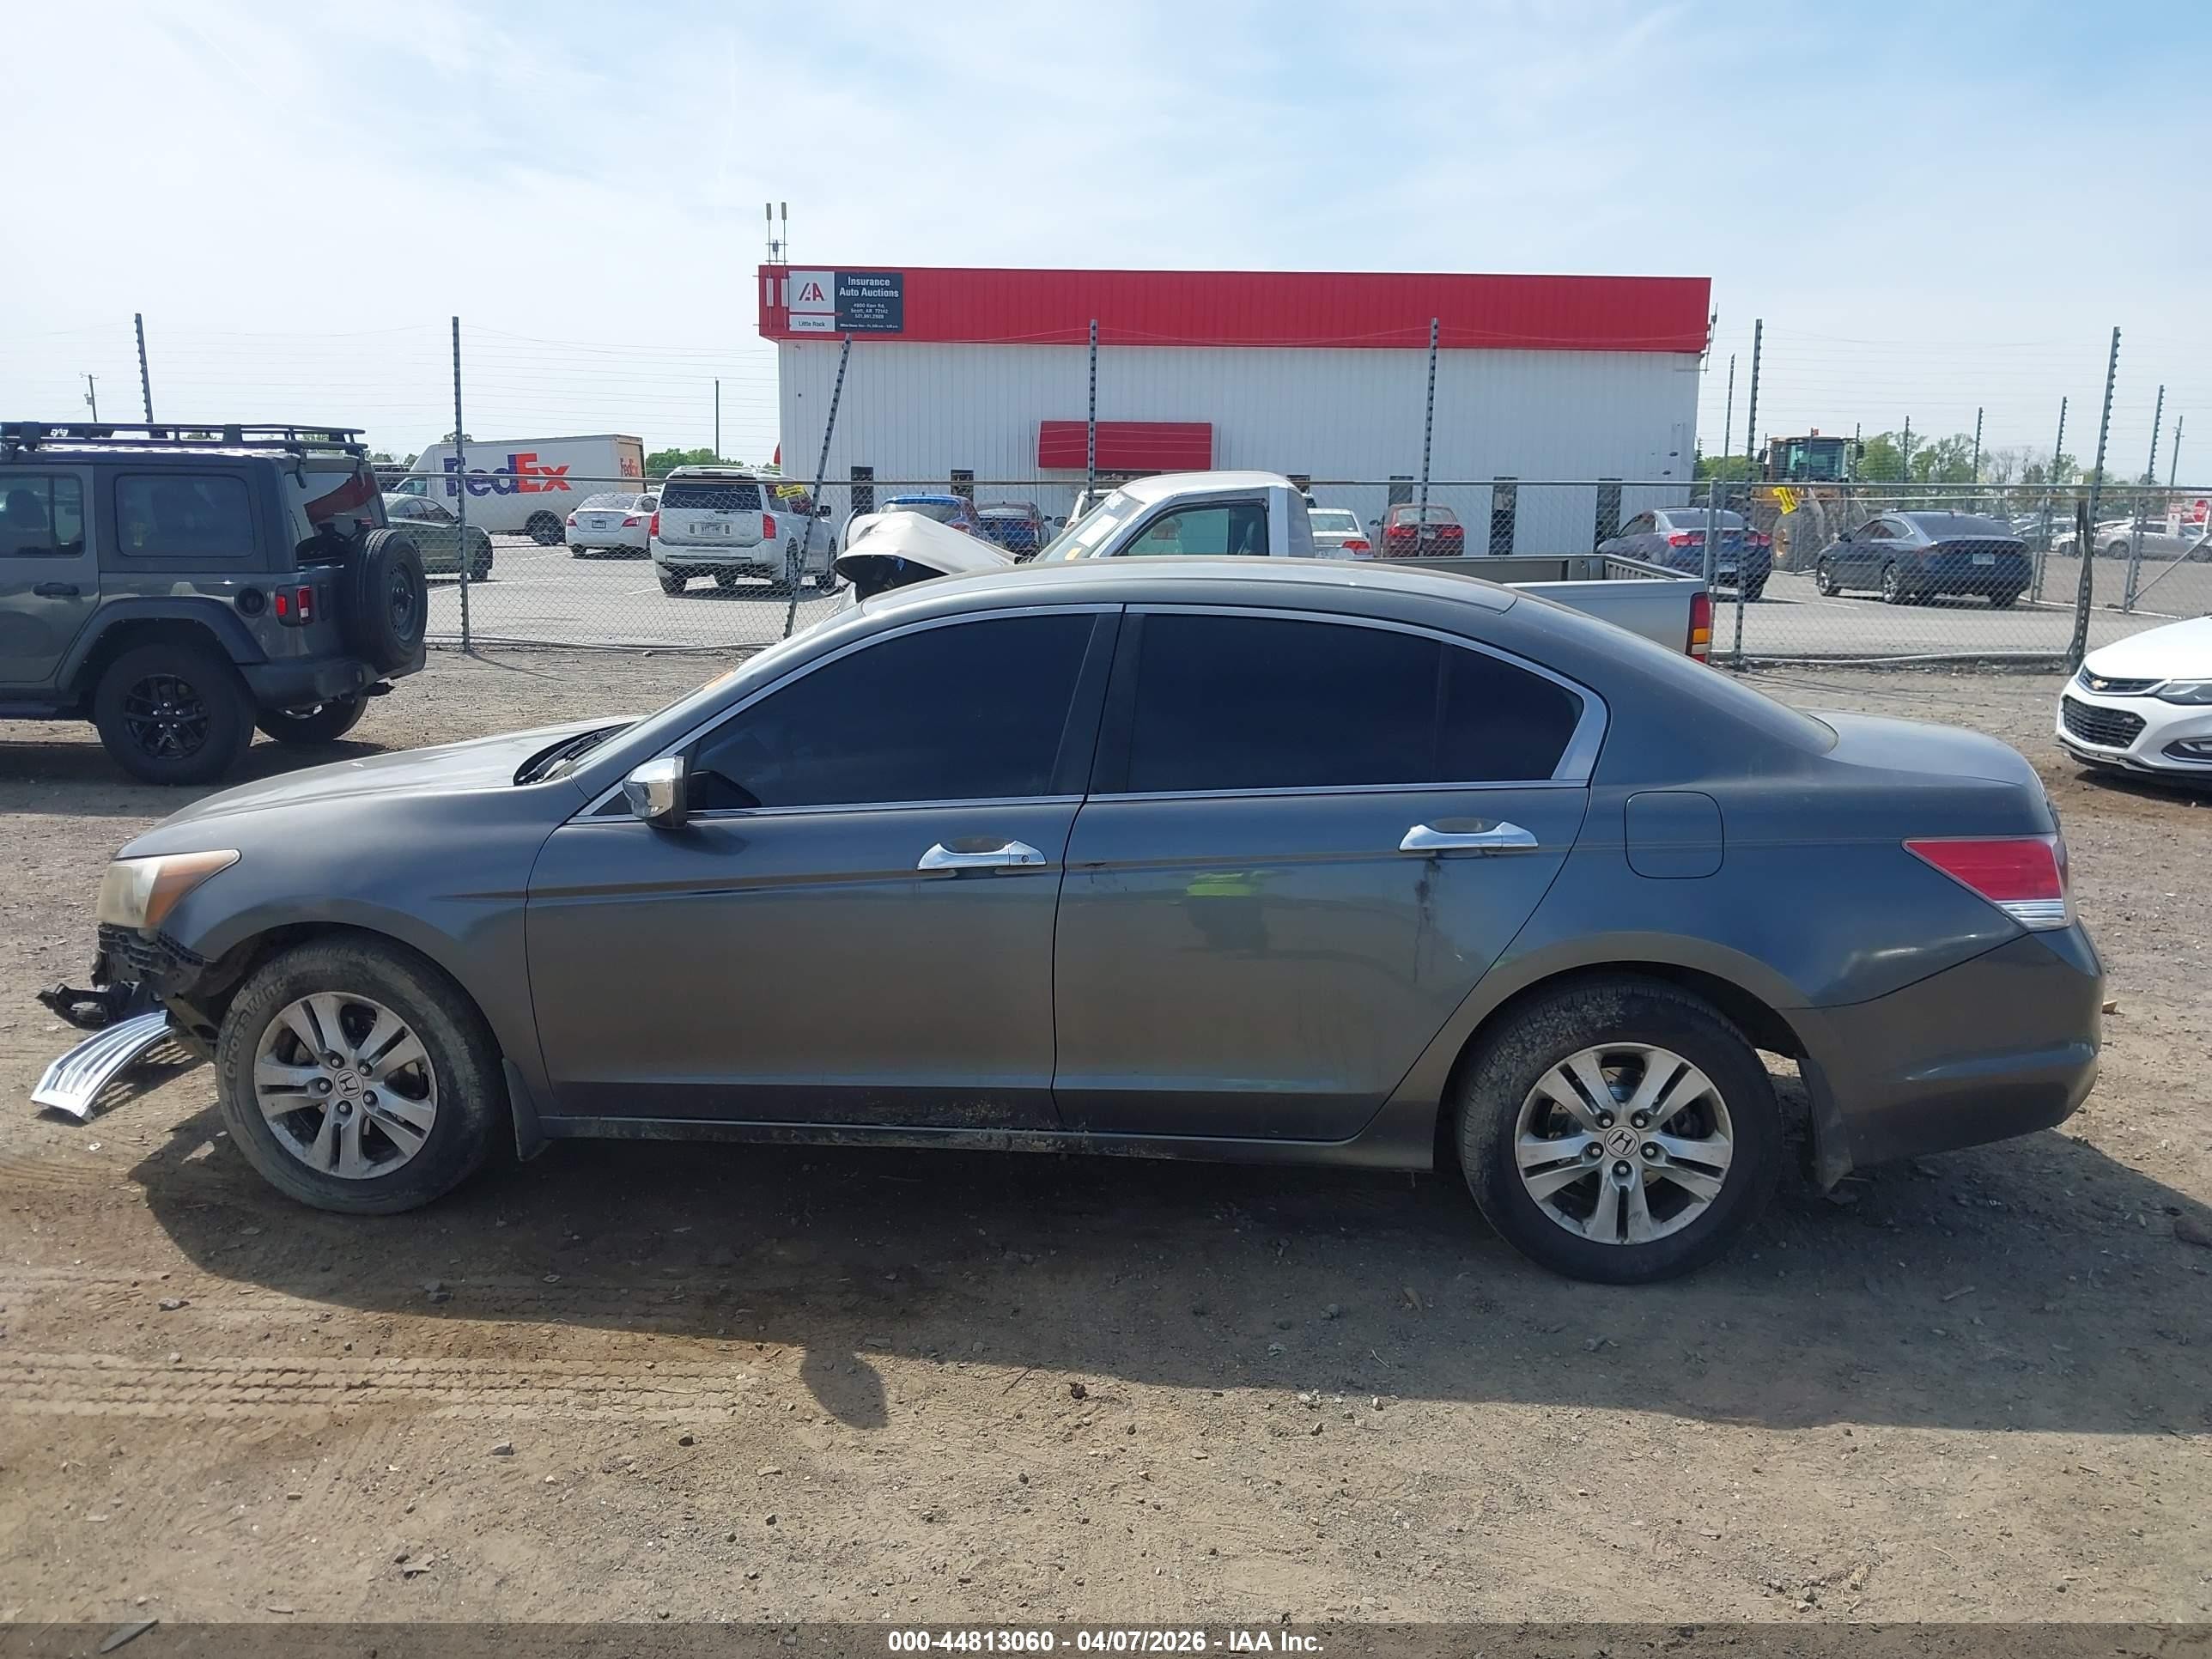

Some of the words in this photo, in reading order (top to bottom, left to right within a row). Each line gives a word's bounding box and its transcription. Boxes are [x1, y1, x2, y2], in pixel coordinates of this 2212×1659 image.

[848, 276, 890, 286] Insurance
[839, 287, 859, 296] Auto
[861, 288, 899, 297] Auctions
[443, 453, 573, 497] FedEx
